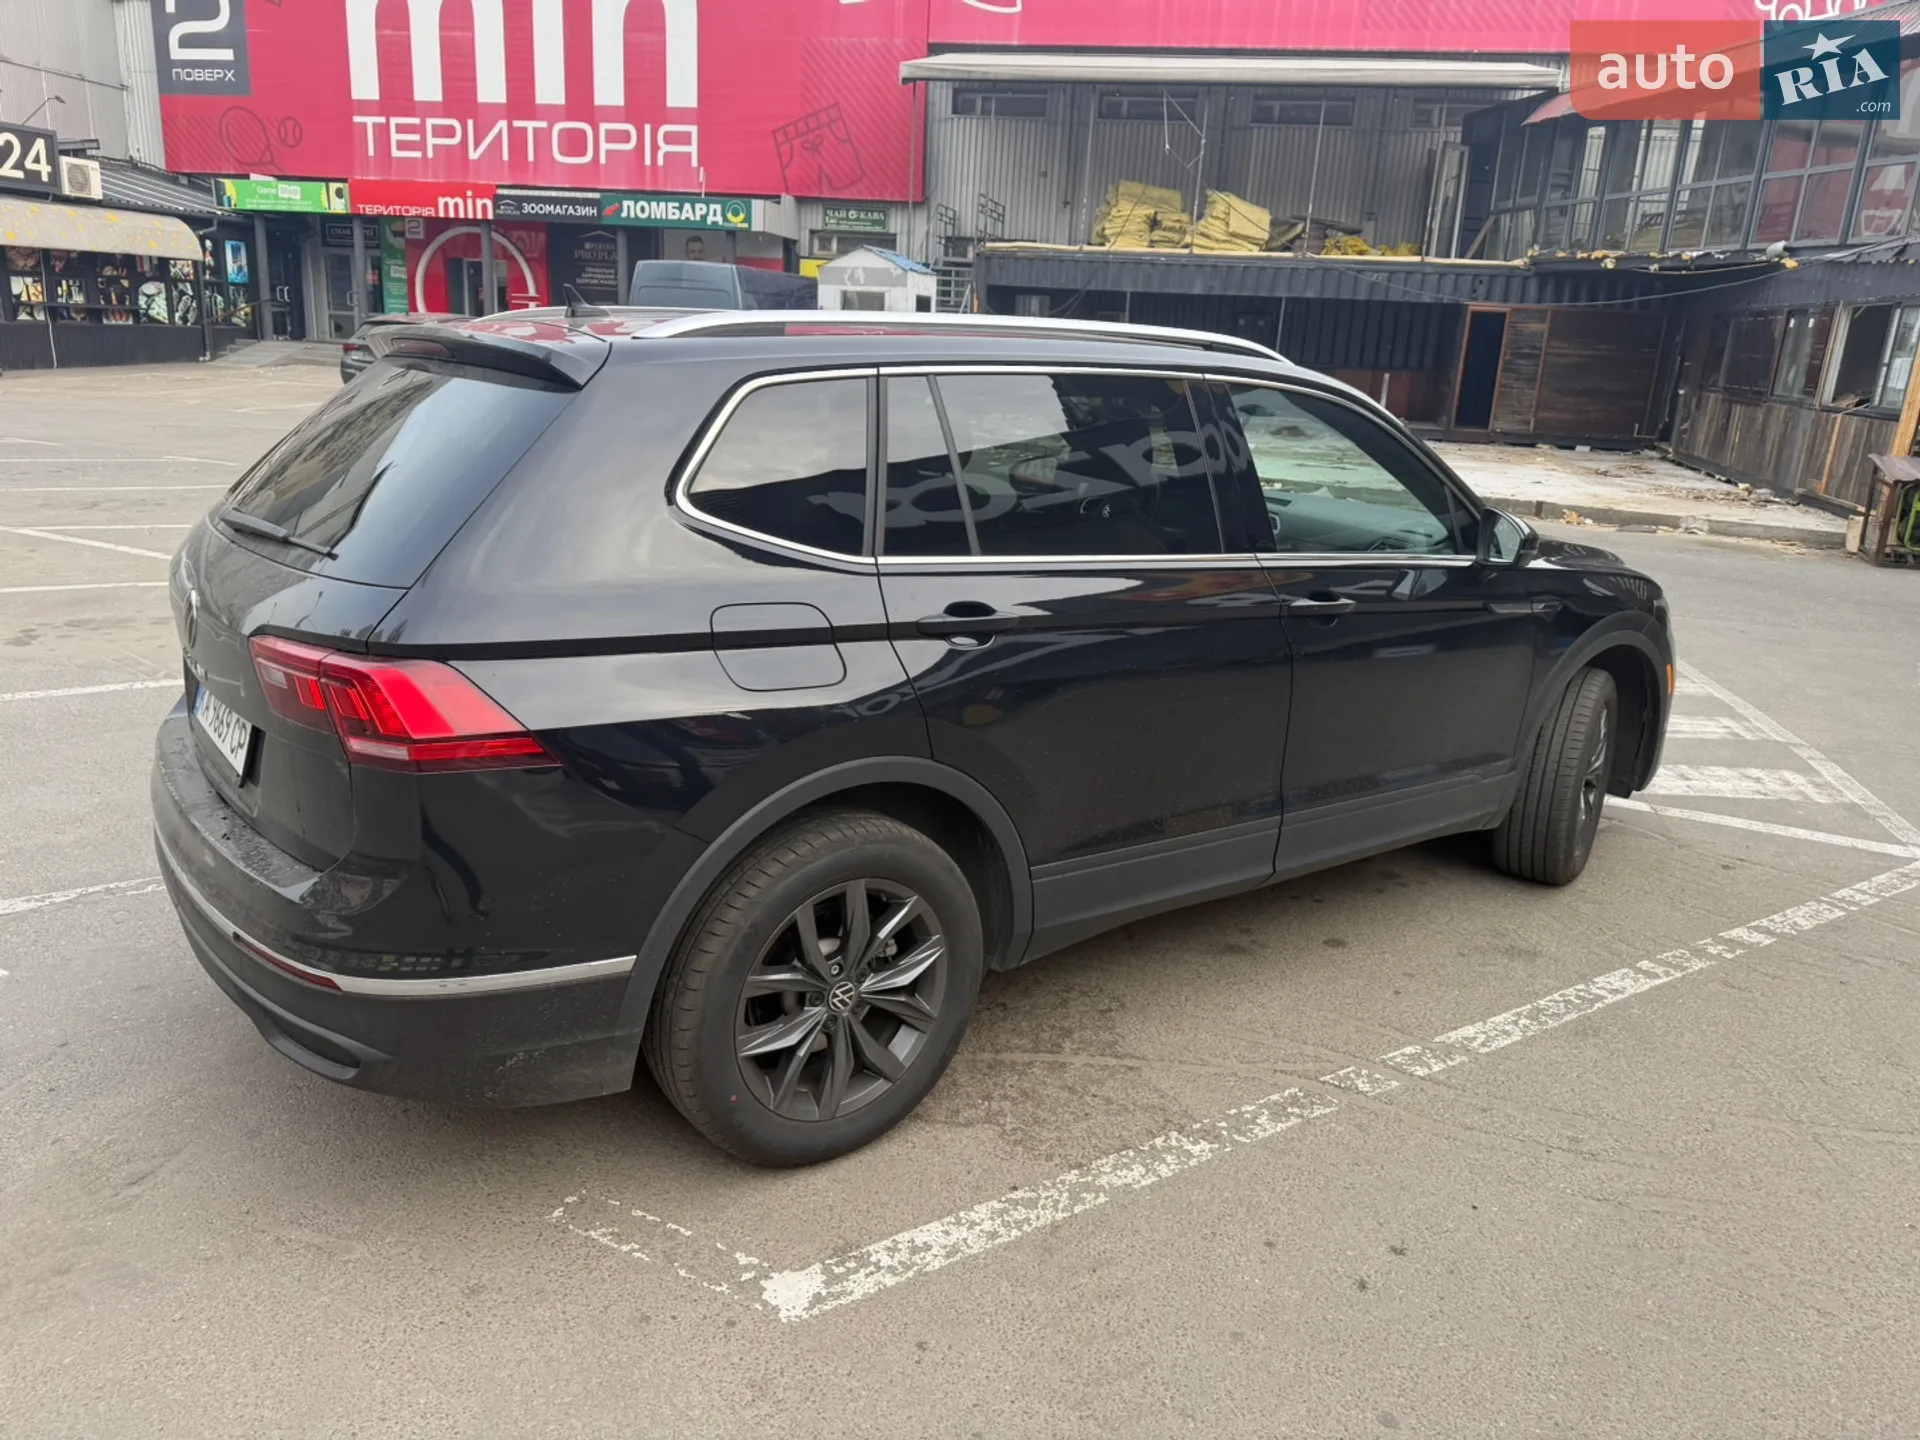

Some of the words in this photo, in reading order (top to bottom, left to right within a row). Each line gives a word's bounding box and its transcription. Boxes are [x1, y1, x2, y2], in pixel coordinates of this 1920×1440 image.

[171, 68, 236, 82] ПОВЕРХ
[352, 115, 699, 168] ТЕРИТОРІЯ
[0, 132, 52, 182] 24
[356, 204, 436, 217] ТЕРИТОРІЯ
[437, 189, 494, 220] min
[521, 202, 598, 217] ЗООМАГАЗИН
[620, 199, 724, 225] ЛОМБАРД
[598, 250, 619, 260] PLA
